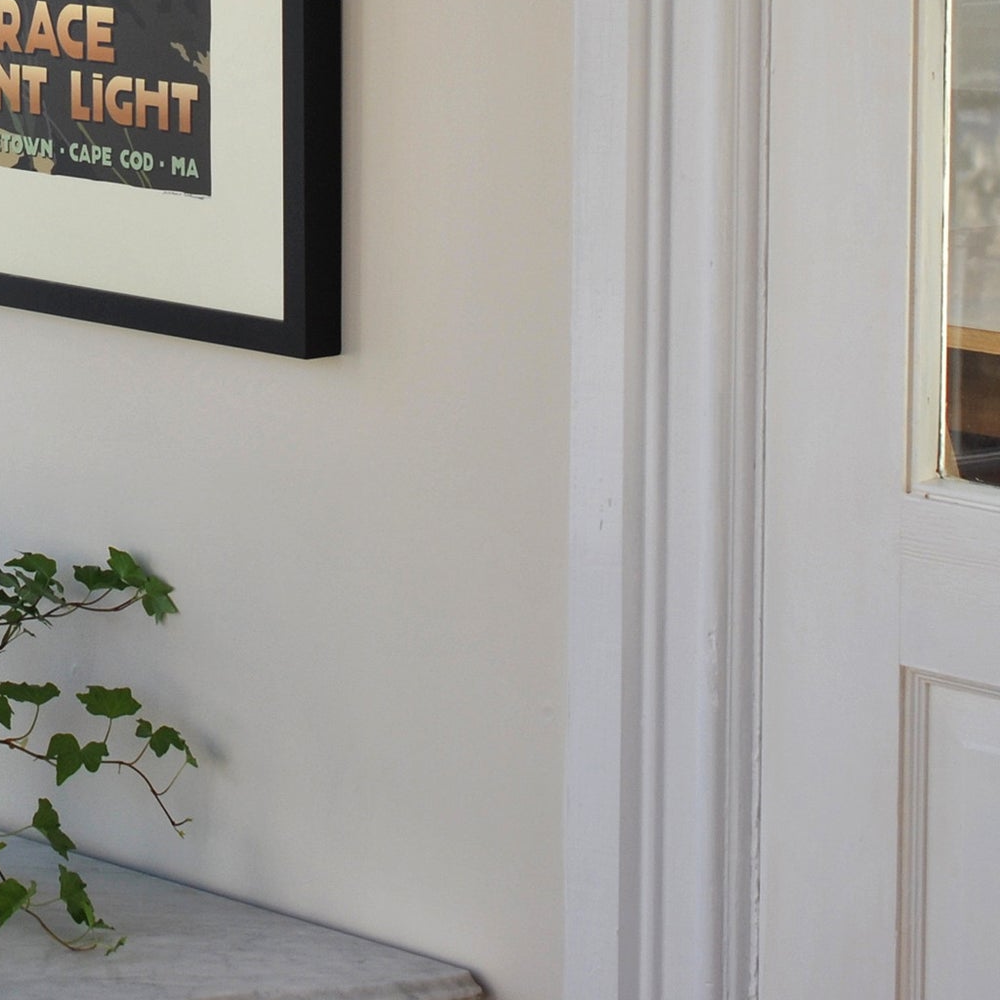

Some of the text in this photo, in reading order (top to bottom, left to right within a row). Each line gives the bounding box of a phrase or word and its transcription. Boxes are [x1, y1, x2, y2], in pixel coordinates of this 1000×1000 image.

[69, 142, 112, 167] CAPE
[120, 149, 154, 171] COD
[171, 155, 199, 178] MA
